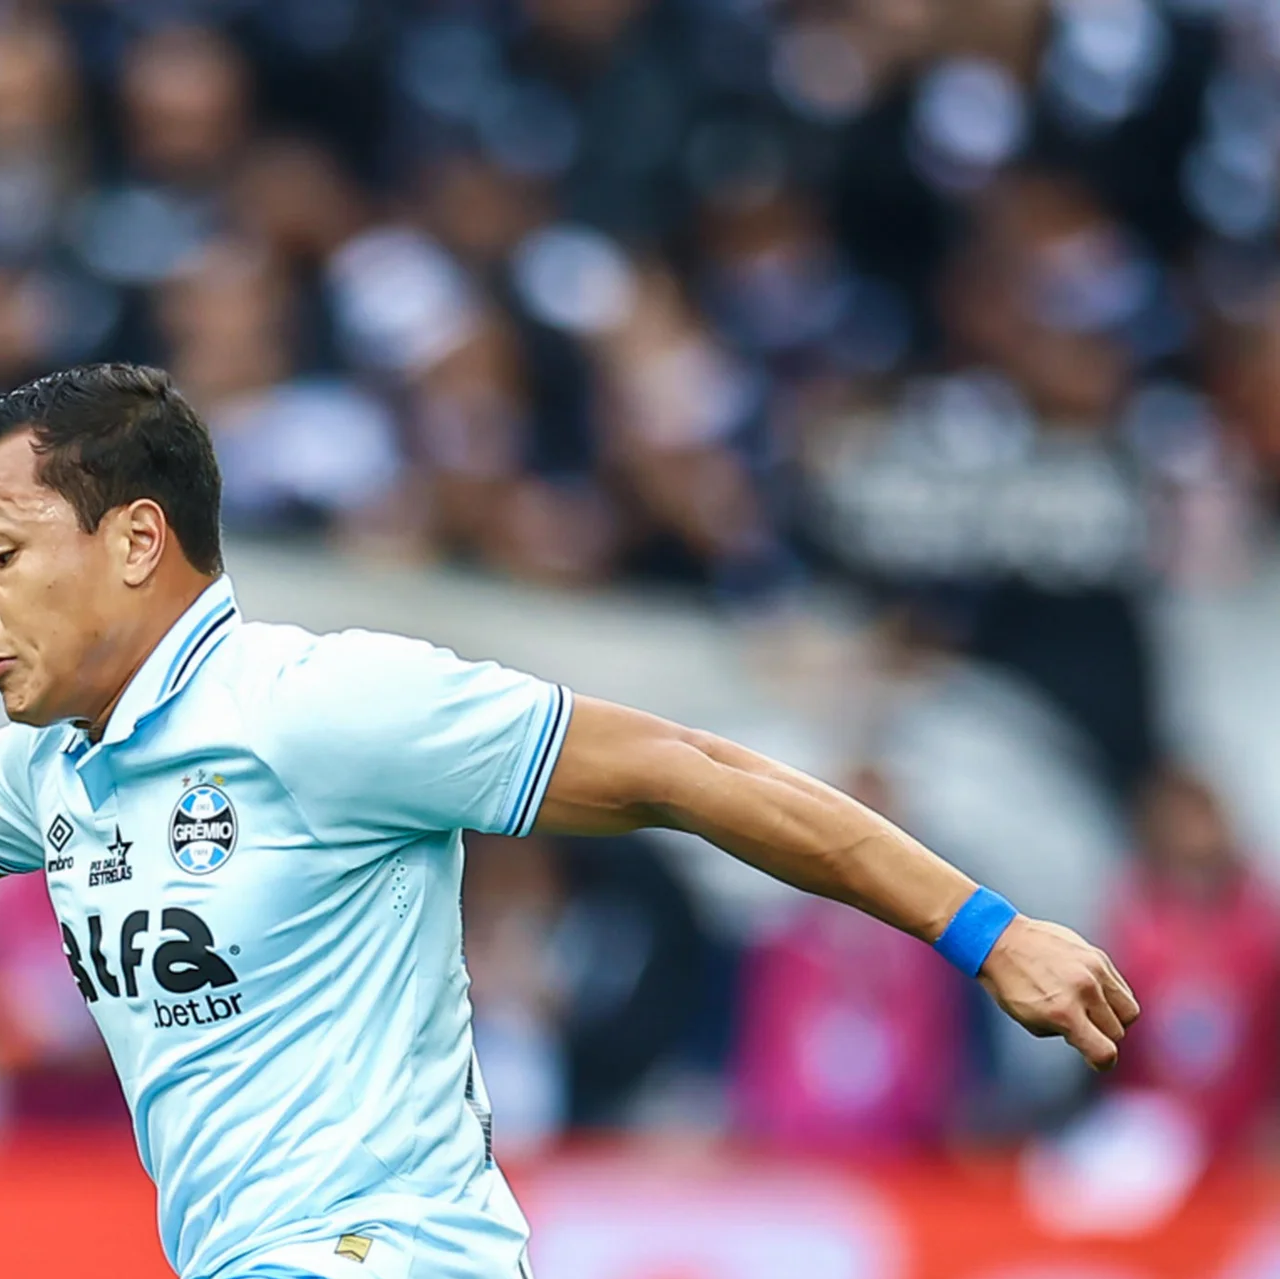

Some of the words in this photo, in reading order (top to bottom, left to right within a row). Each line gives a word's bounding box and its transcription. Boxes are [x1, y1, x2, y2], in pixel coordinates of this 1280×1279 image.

[173, 818, 234, 842] GRÊMIO
[89, 865, 132, 887] ESTRELAS
[153, 992, 242, 1029] .bet.br
